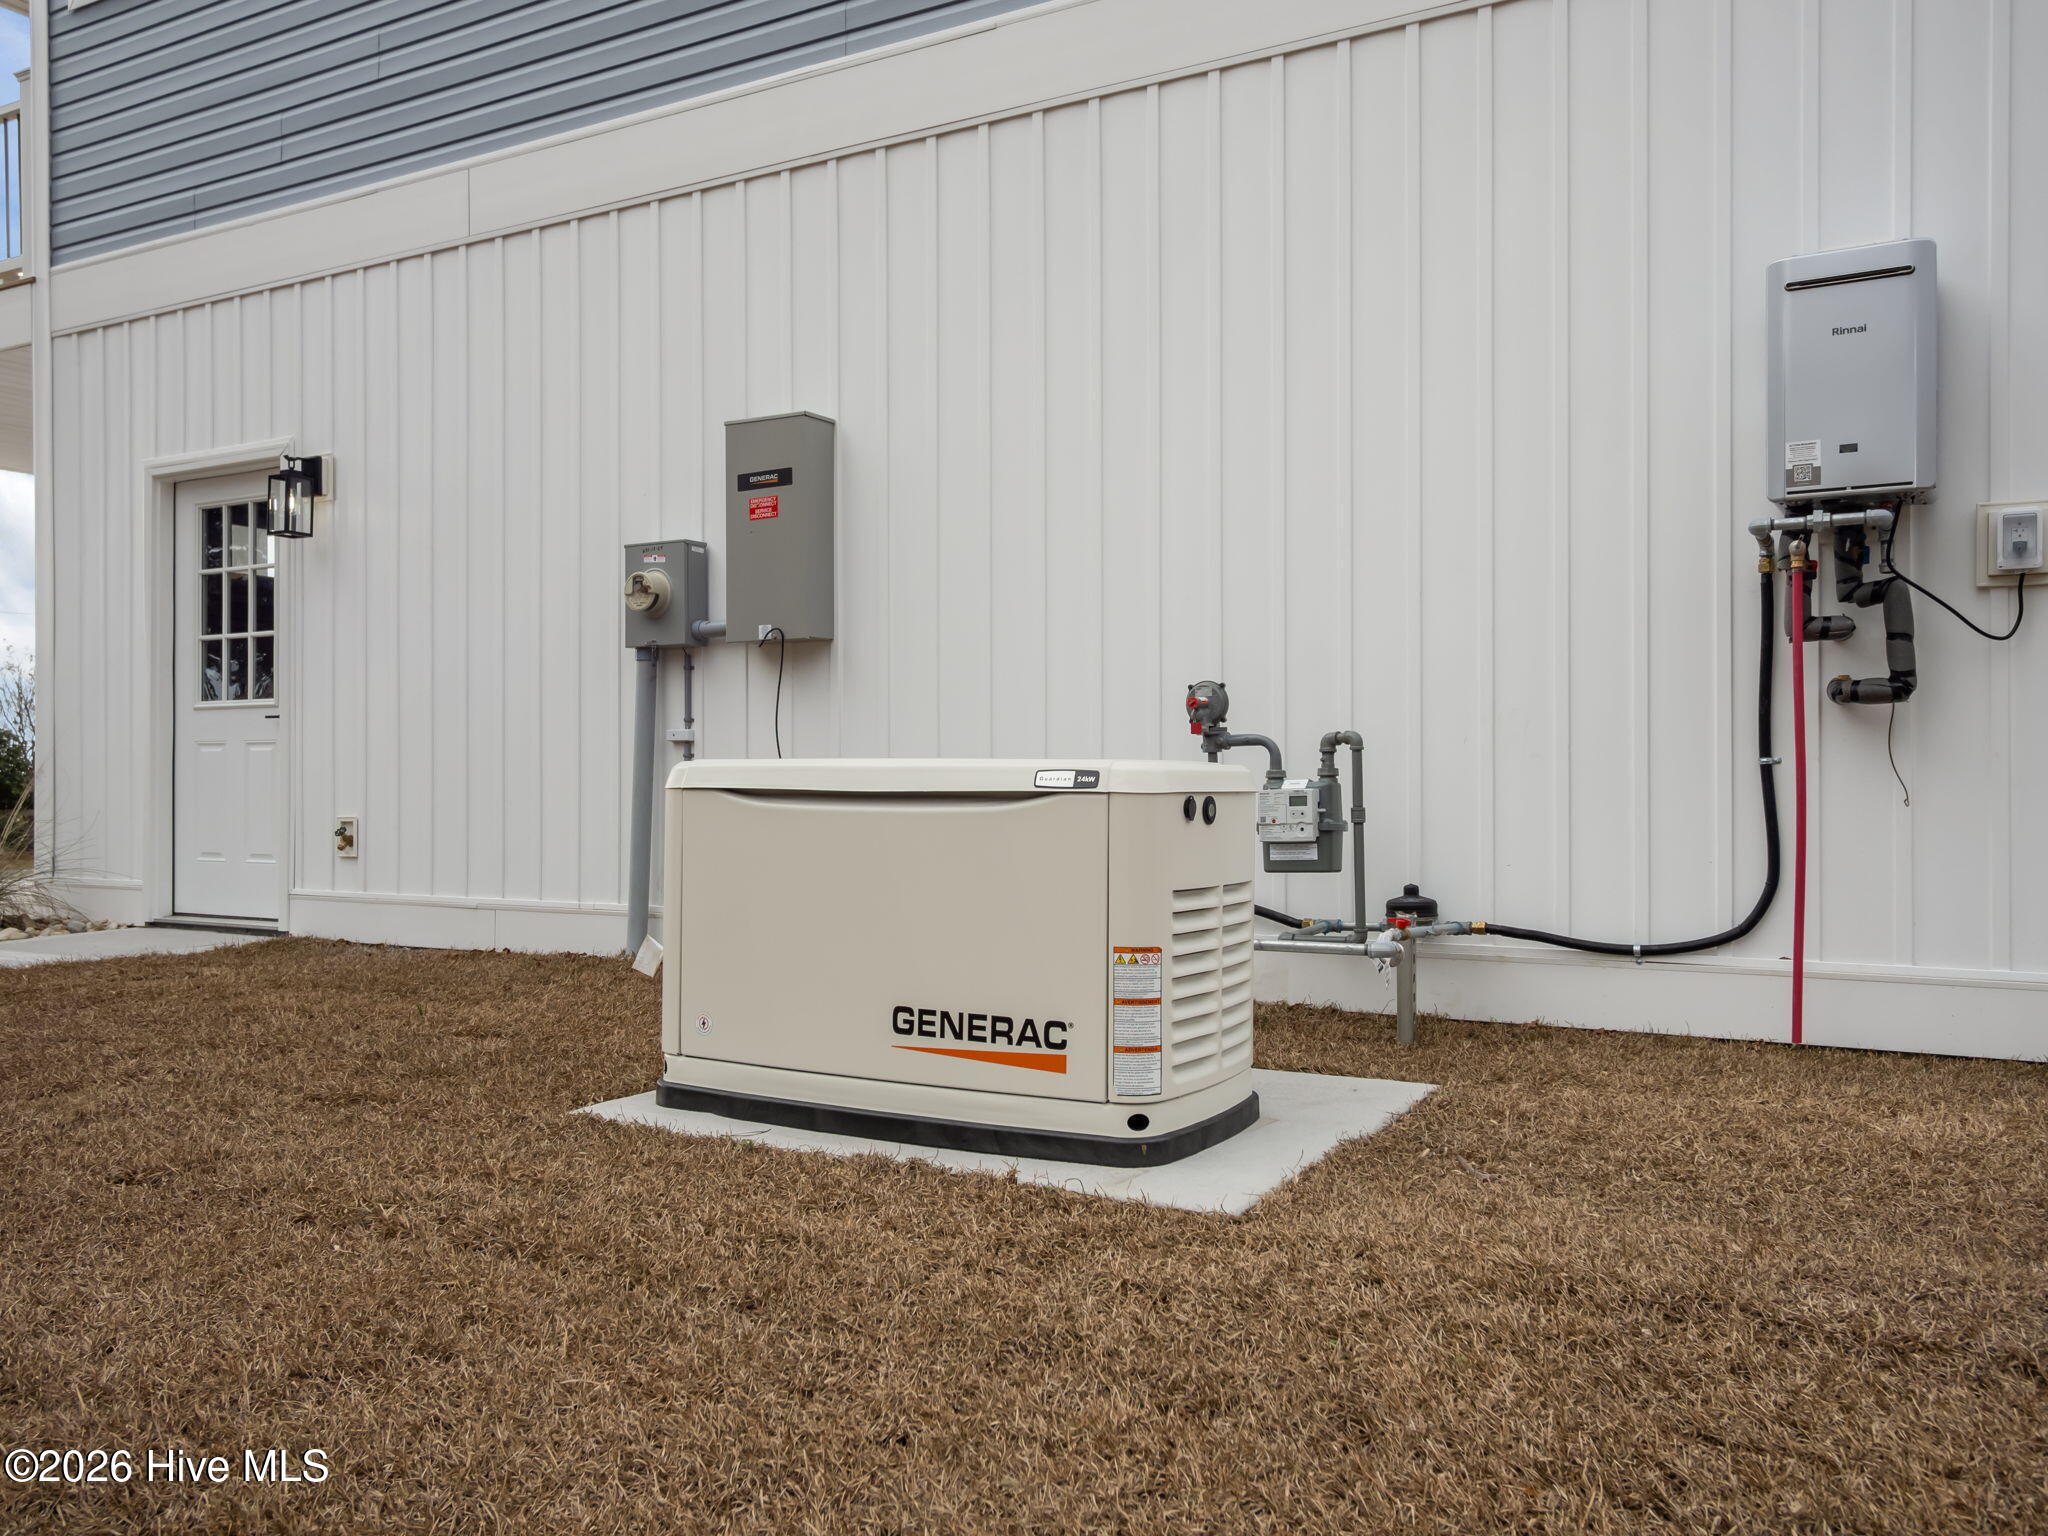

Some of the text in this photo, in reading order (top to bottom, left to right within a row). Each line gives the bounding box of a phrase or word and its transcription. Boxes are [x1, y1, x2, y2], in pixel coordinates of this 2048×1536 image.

[1831, 323, 1867, 336] Rinnai
[749, 473, 778, 482] GENERAC
[1077, 775, 1096, 783] 24kW
